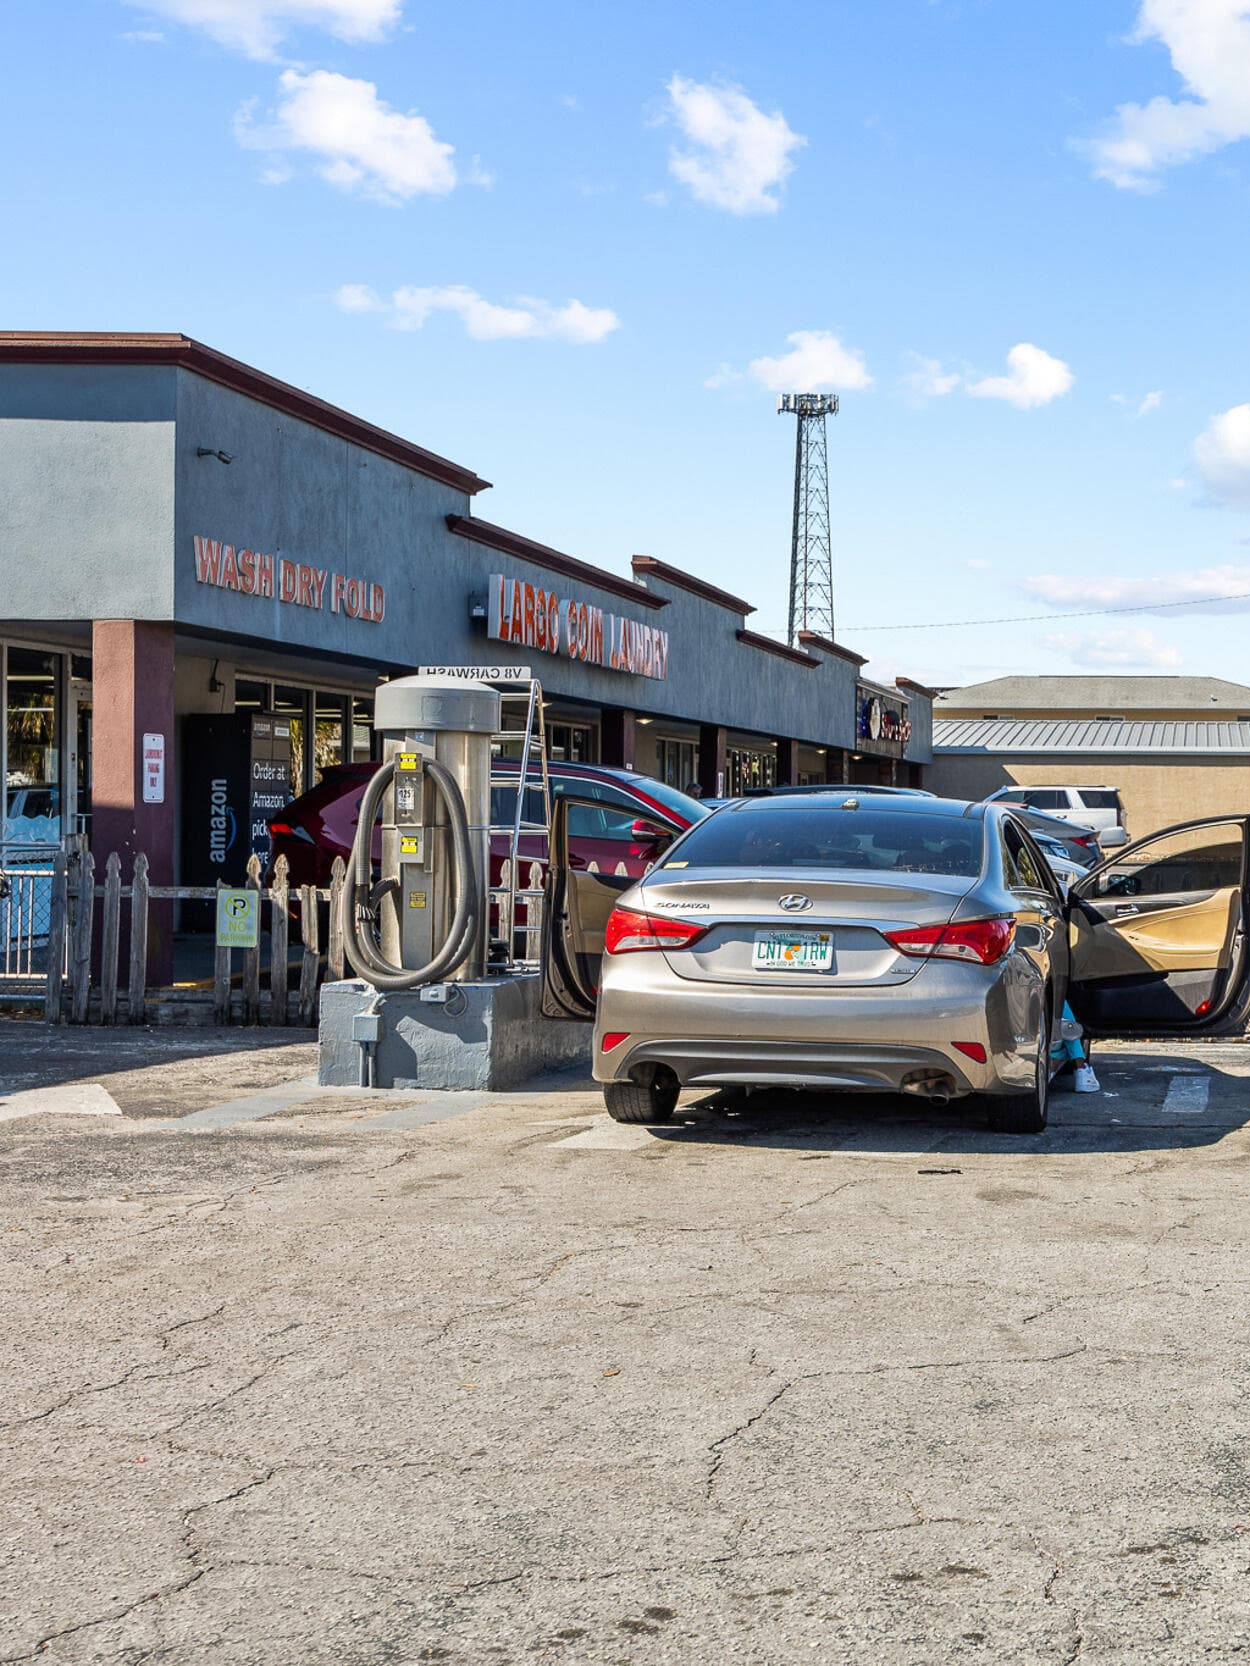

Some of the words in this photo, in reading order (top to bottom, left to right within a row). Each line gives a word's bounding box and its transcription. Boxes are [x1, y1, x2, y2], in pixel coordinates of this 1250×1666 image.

[194, 535, 275, 599] WASH
[279, 559, 328, 610] DRY
[331, 572, 386, 624] FOLD
[497, 574, 560, 655] LARGO
[566, 598, 605, 665] COIN
[609, 612, 669, 682] LAUNDRY
[253, 762, 275, 780] Order
[277, 765, 286, 780] at
[209, 778, 228, 863] amazon
[228, 921, 248, 933] NO
